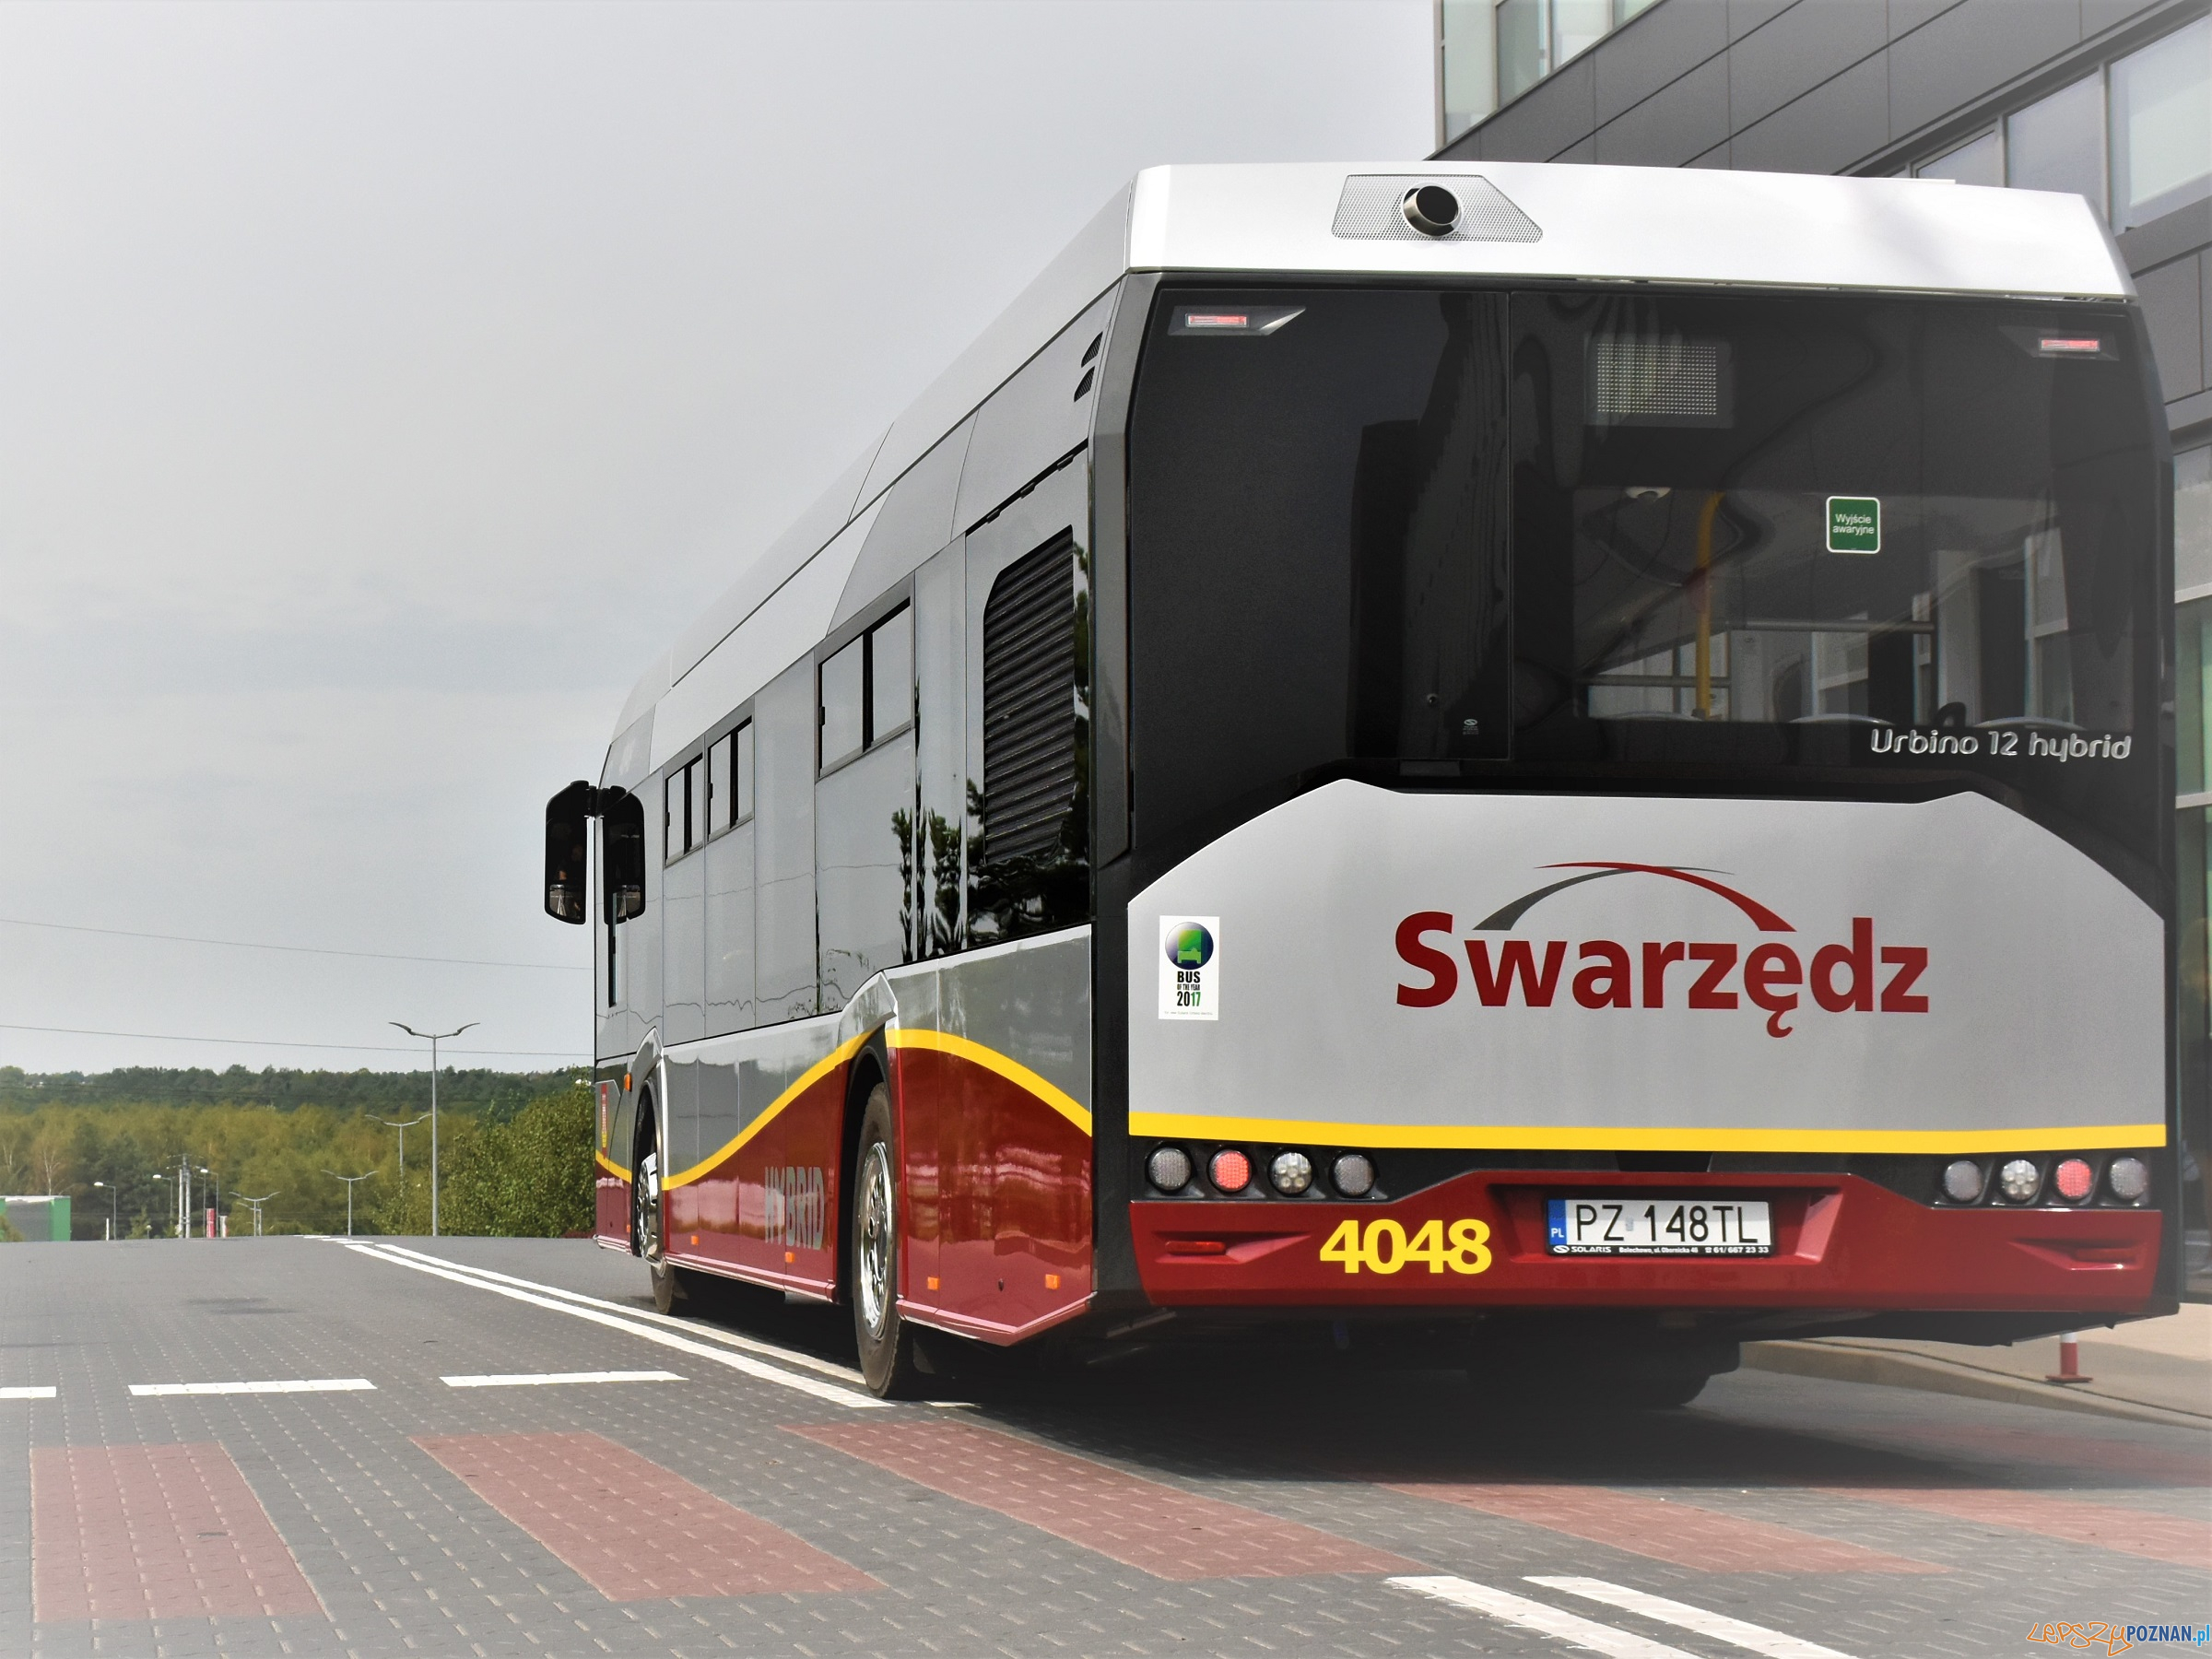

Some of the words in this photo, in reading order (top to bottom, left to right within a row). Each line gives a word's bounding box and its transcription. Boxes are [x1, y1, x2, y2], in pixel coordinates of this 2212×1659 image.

[1832, 524, 1875, 535] awaryjne
[1835, 513, 1872, 524] Wyjście
[1871, 728, 1979, 755] Urbino
[1988, 731, 2018, 756] 12
[2029, 732, 2132, 762] hybrid
[1177, 971, 1201, 983] BUS
[1394, 911, 1930, 1038] Swarzędz
[1177, 991, 1201, 1006] 2017
[765, 1166, 825, 1251] HYBRID
[1550, 1228, 1565, 1238] PL
[1576, 1204, 1625, 1241] PZ
[1643, 1205, 1759, 1243] 148TL
[1319, 1218, 1492, 1275] 4048
